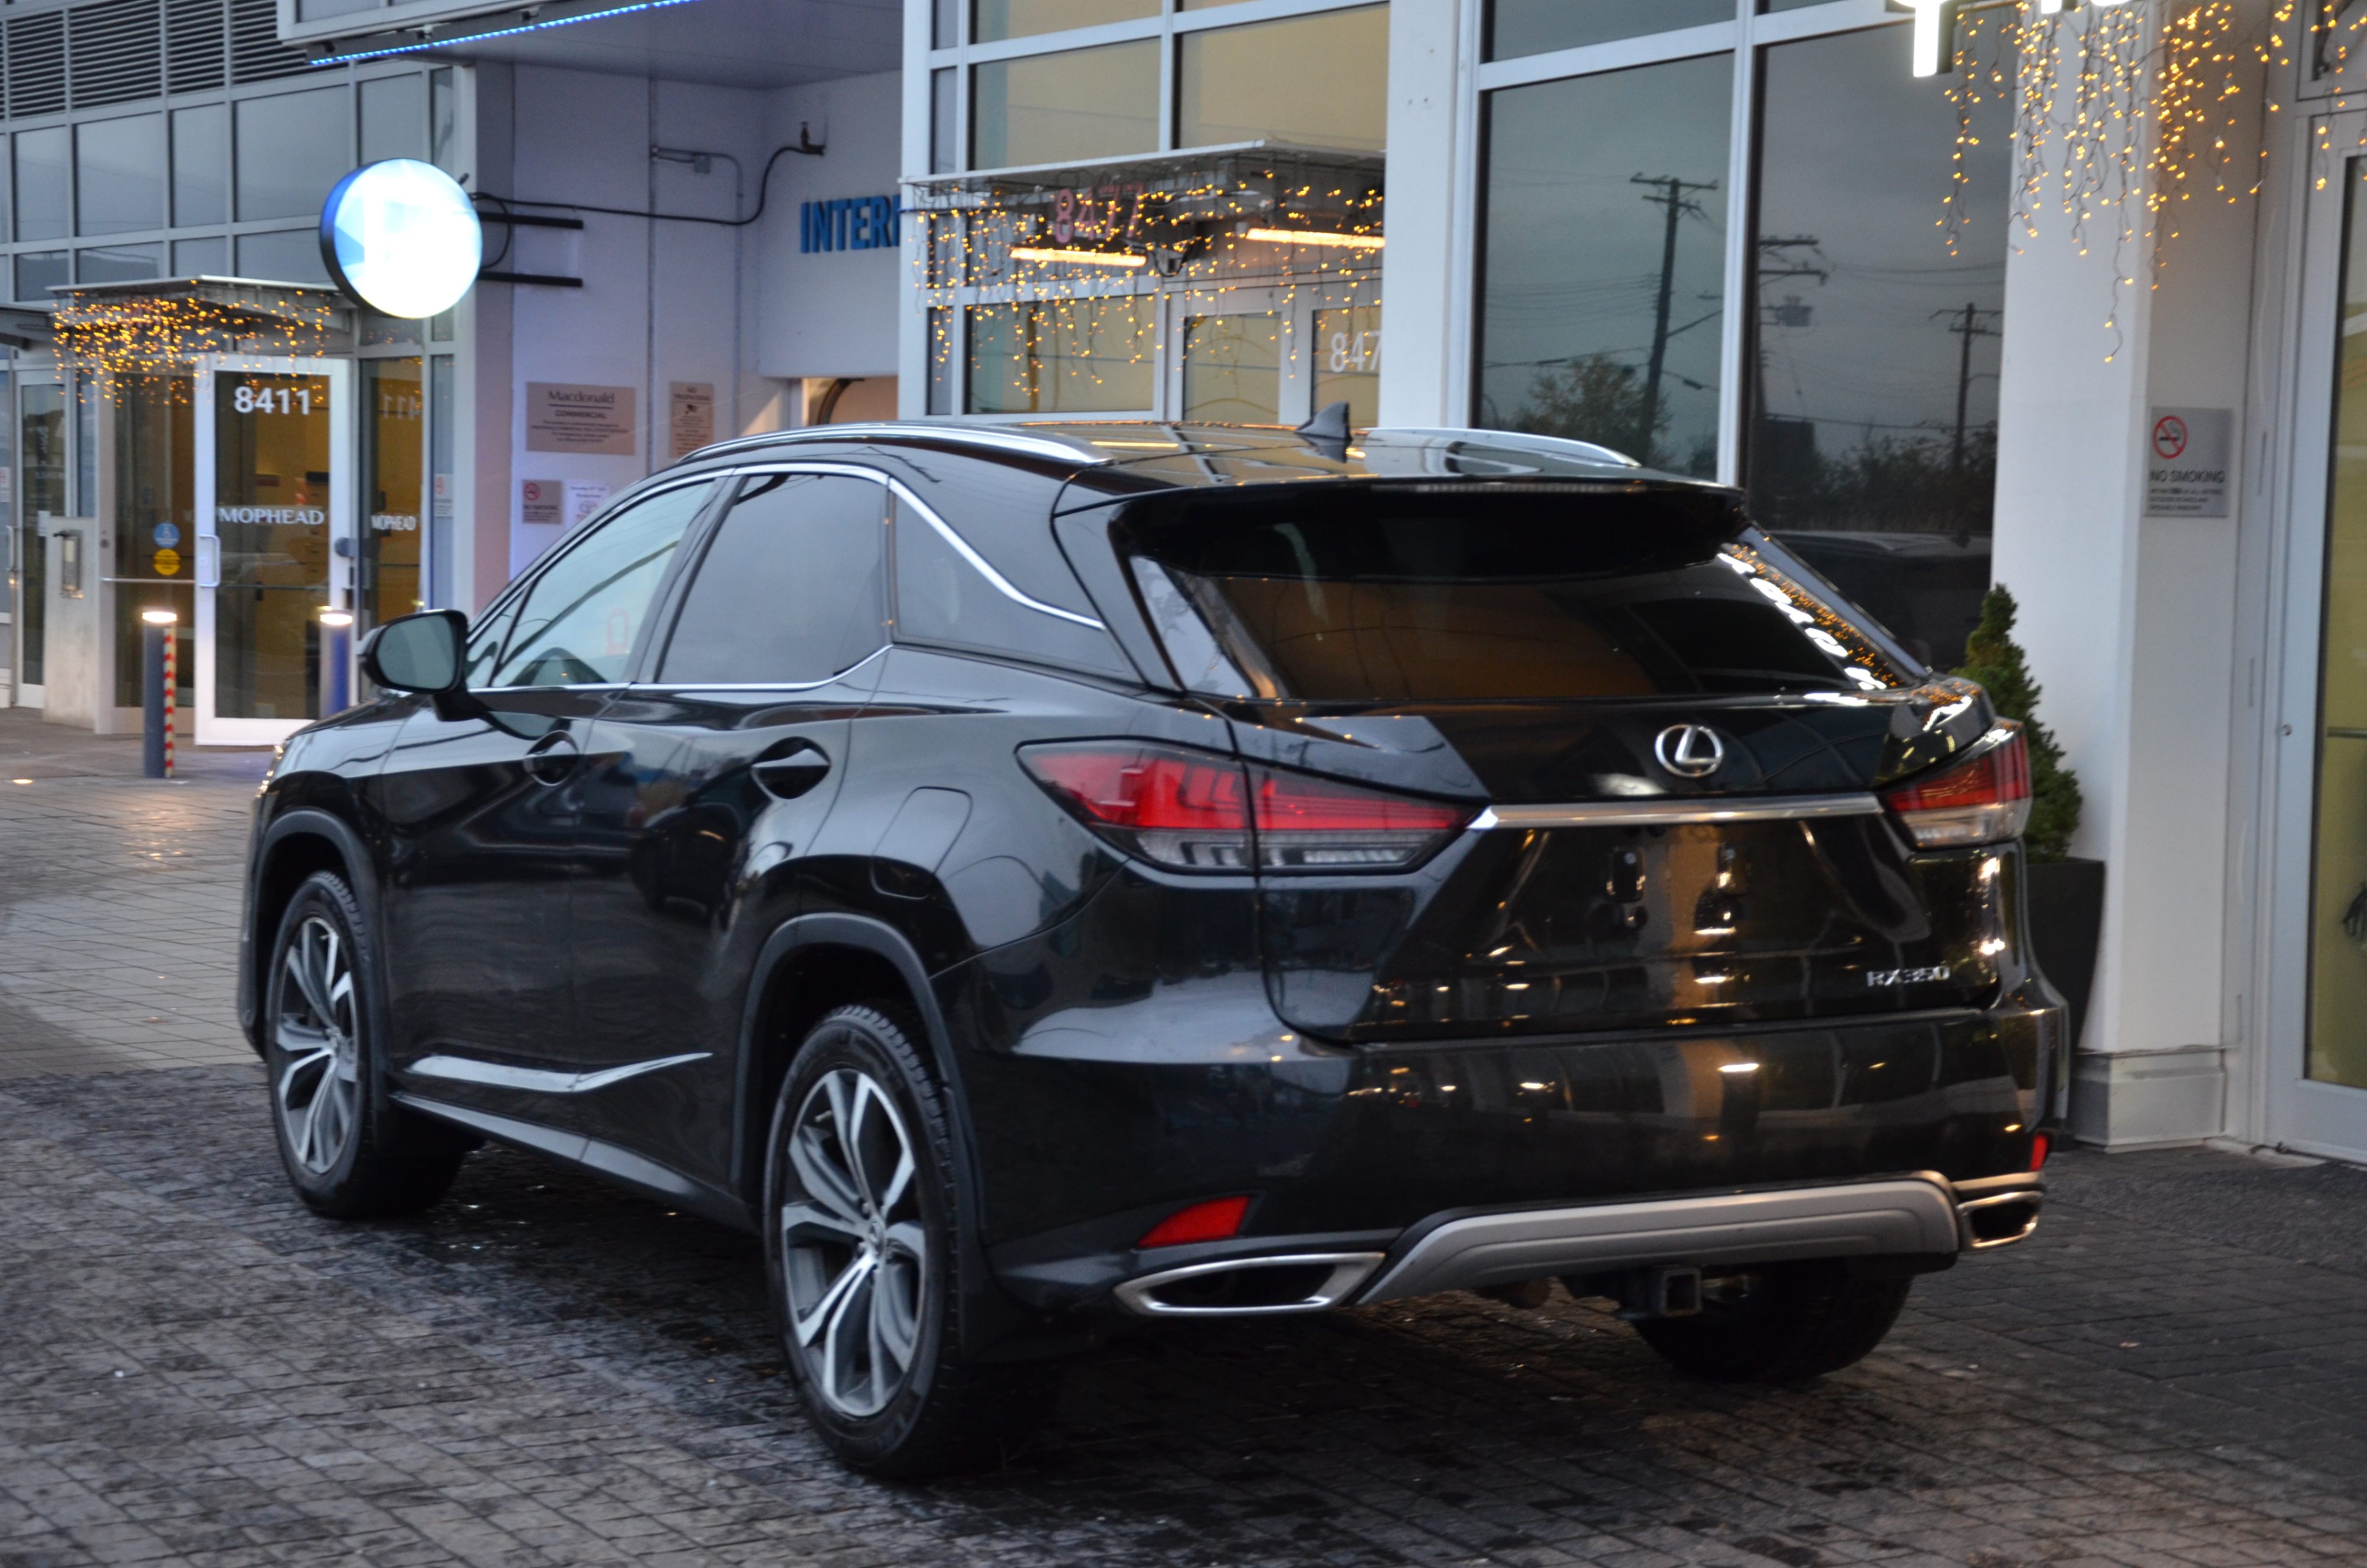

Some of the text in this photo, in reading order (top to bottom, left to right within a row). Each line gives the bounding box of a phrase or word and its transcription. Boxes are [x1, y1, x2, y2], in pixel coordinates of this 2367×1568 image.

[1055, 182, 1145, 244] 8477
[234, 386, 310, 415] 8411
[548, 391, 615, 404] Macdonald
[2150, 470, 2225, 483] NO SMOKING
[218, 508, 325, 525] MOPHEAD
